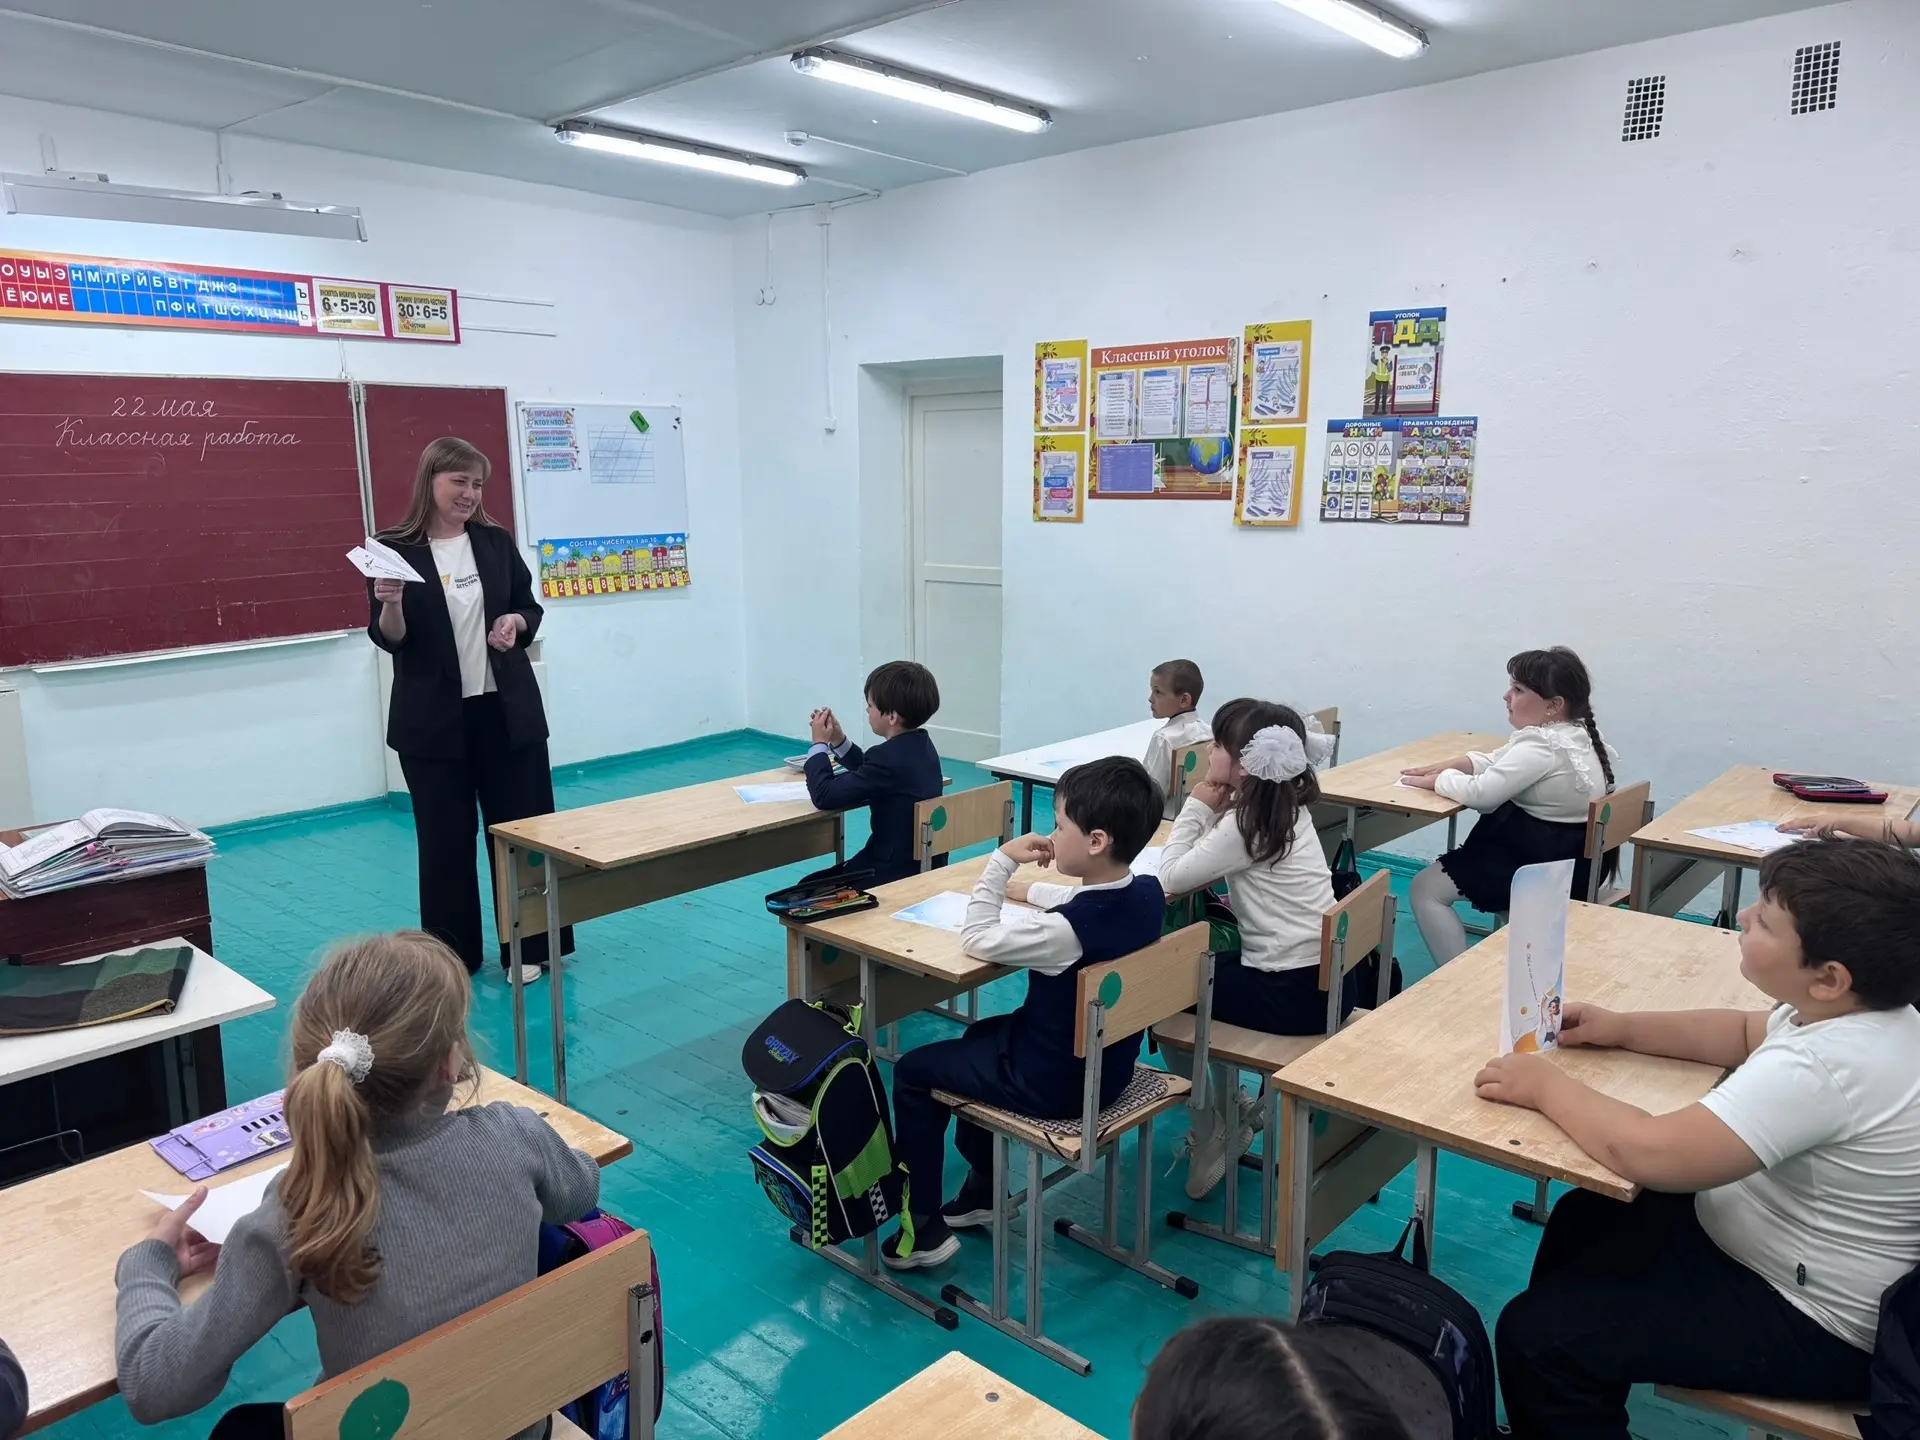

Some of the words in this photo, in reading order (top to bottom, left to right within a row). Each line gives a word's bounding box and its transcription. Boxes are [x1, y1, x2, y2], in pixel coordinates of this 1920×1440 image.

[1373, 318, 1440, 347] ПДД
[1101, 348, 1170, 364] Классный
[1173, 345, 1226, 363] уголок
[111, 396, 147, 417] 22
[152, 399, 220, 418] мая
[55, 416, 194, 447] Классная
[199, 420, 302, 462] работа
[764, 1035, 801, 1065] GRIZZLY
